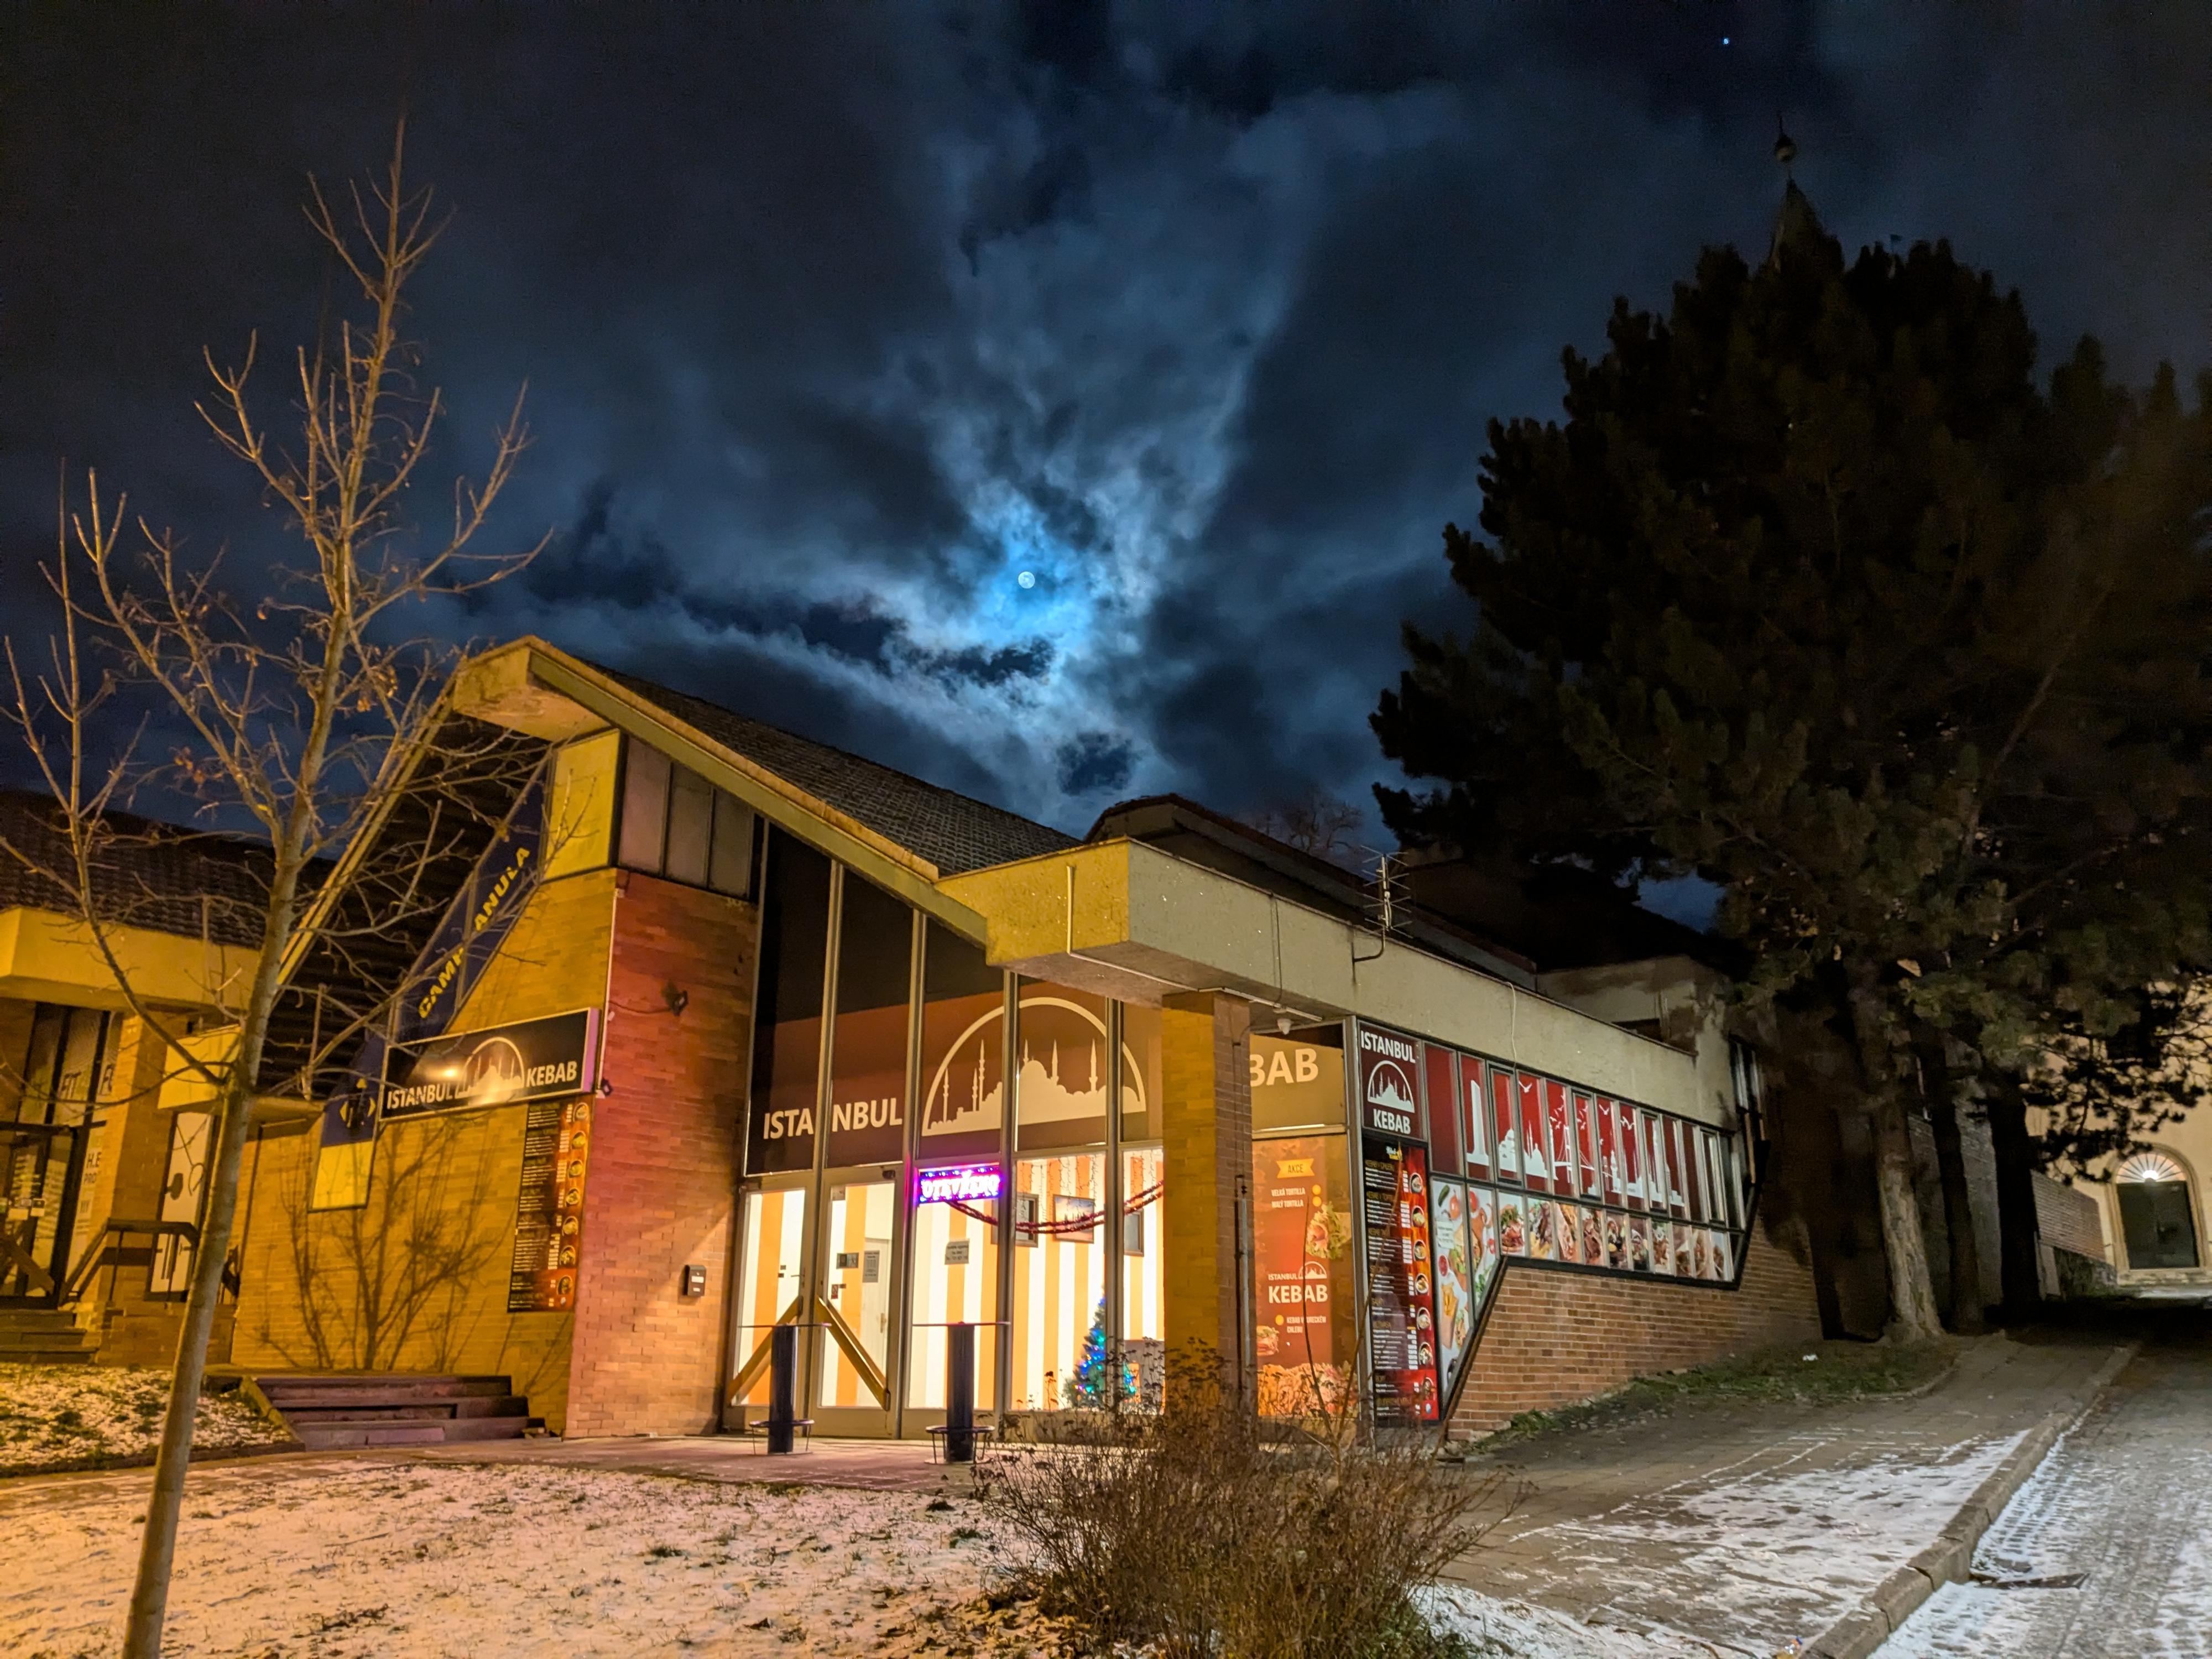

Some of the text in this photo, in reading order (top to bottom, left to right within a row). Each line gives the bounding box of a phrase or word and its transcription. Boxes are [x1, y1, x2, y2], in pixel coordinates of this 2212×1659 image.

[1361, 1030, 1416, 1063] ISTANBUL
[1250, 1048, 1318, 1087] BAB
[387, 1061, 577, 1109] ISTANBUL KEBAB
[1373, 1109, 1411, 1134] KEBAB
[1287, 1164, 1304, 1173] AKCE
[1269, 1284, 1328, 1303] KEBAB
